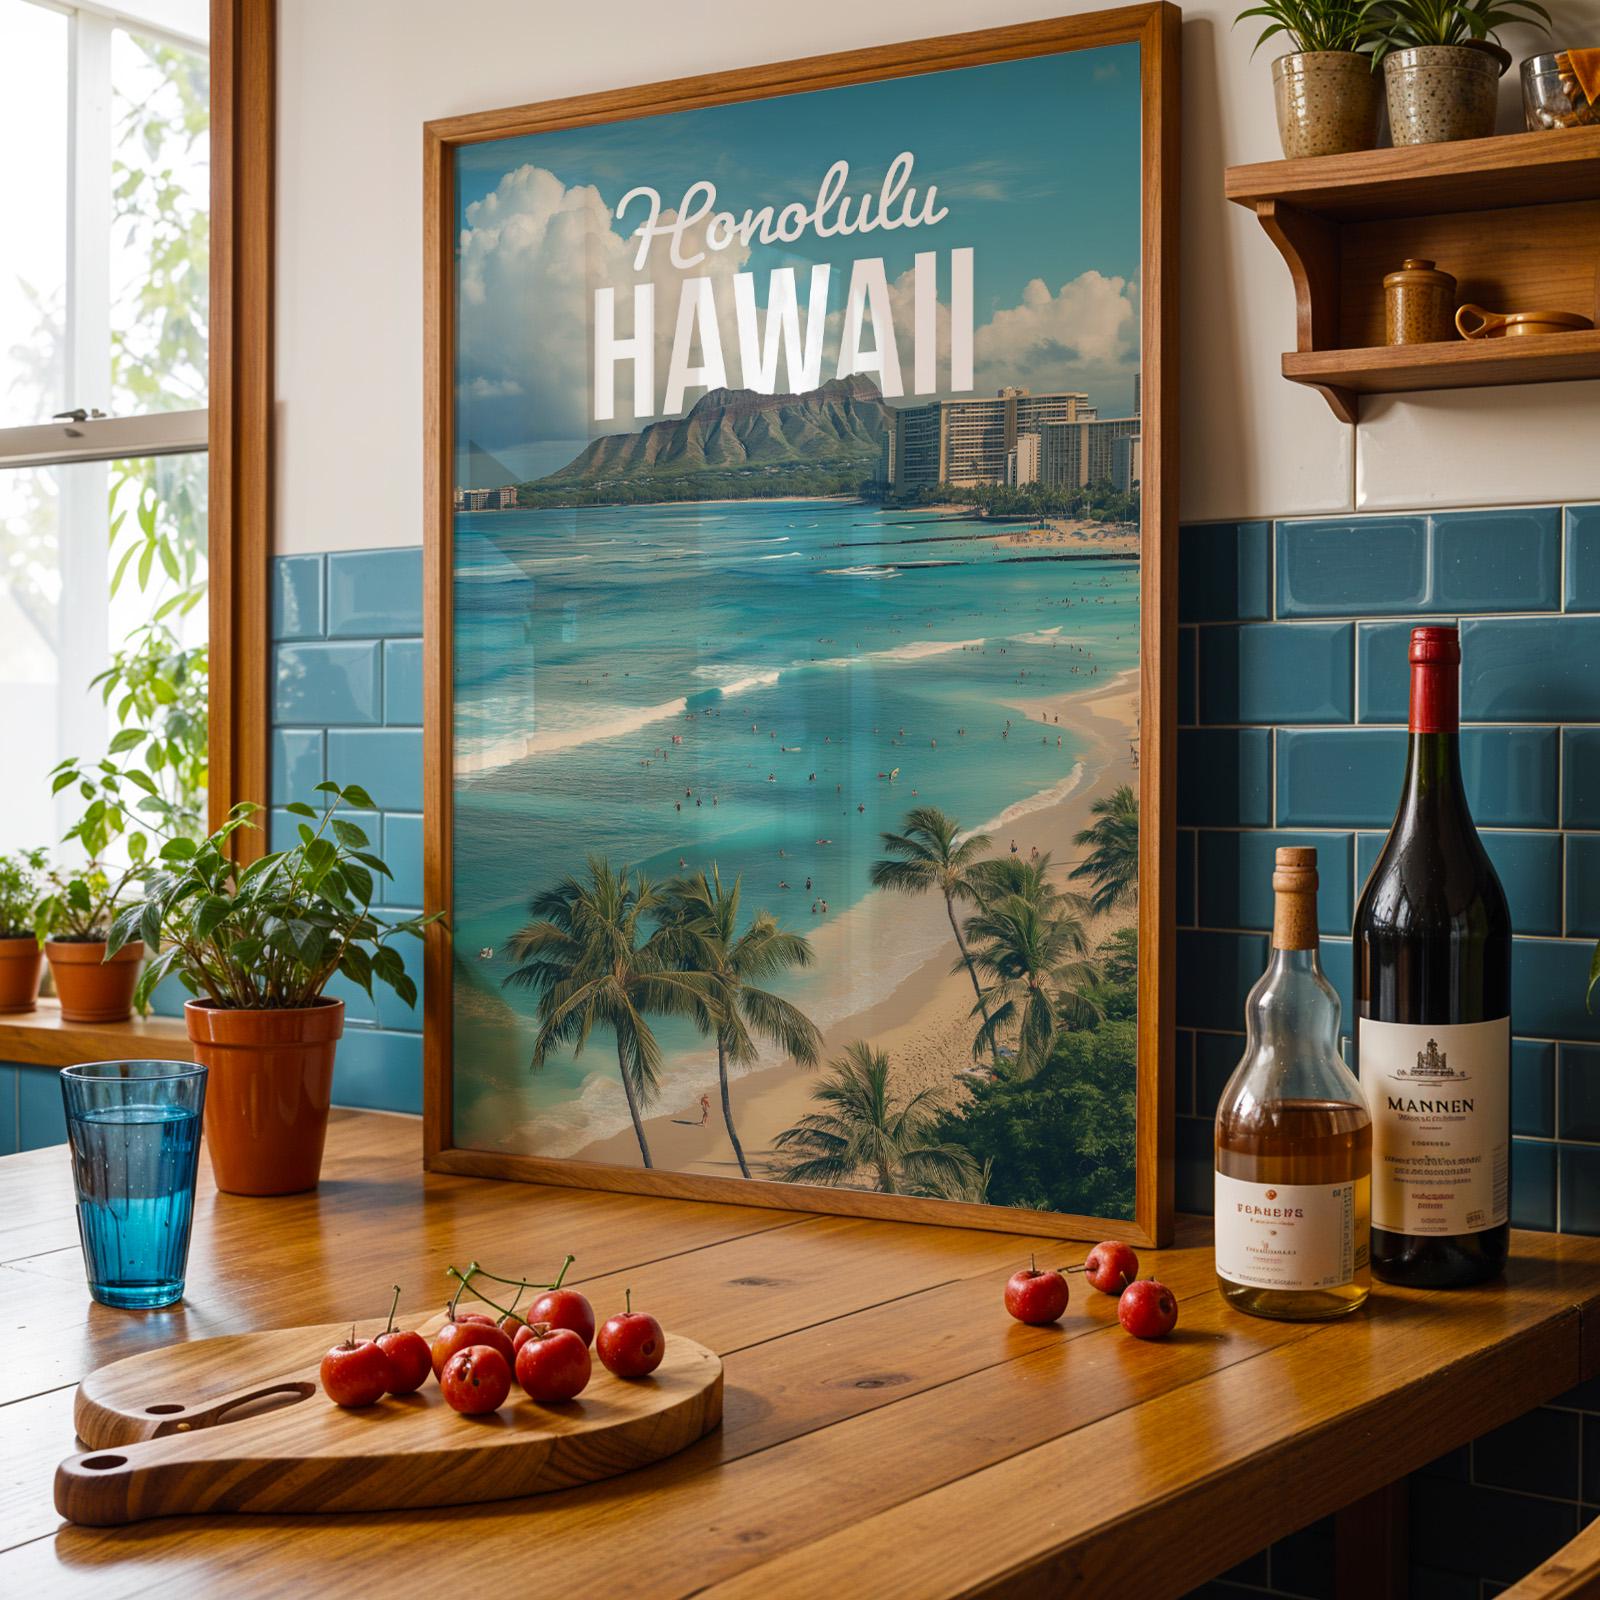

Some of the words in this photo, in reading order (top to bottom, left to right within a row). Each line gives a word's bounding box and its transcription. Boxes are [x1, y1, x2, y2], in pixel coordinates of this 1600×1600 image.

[616, 151, 949, 271] Honolulu
[595, 247, 974, 421] HAWAII
[1388, 1096, 1474, 1113] MANNEN
